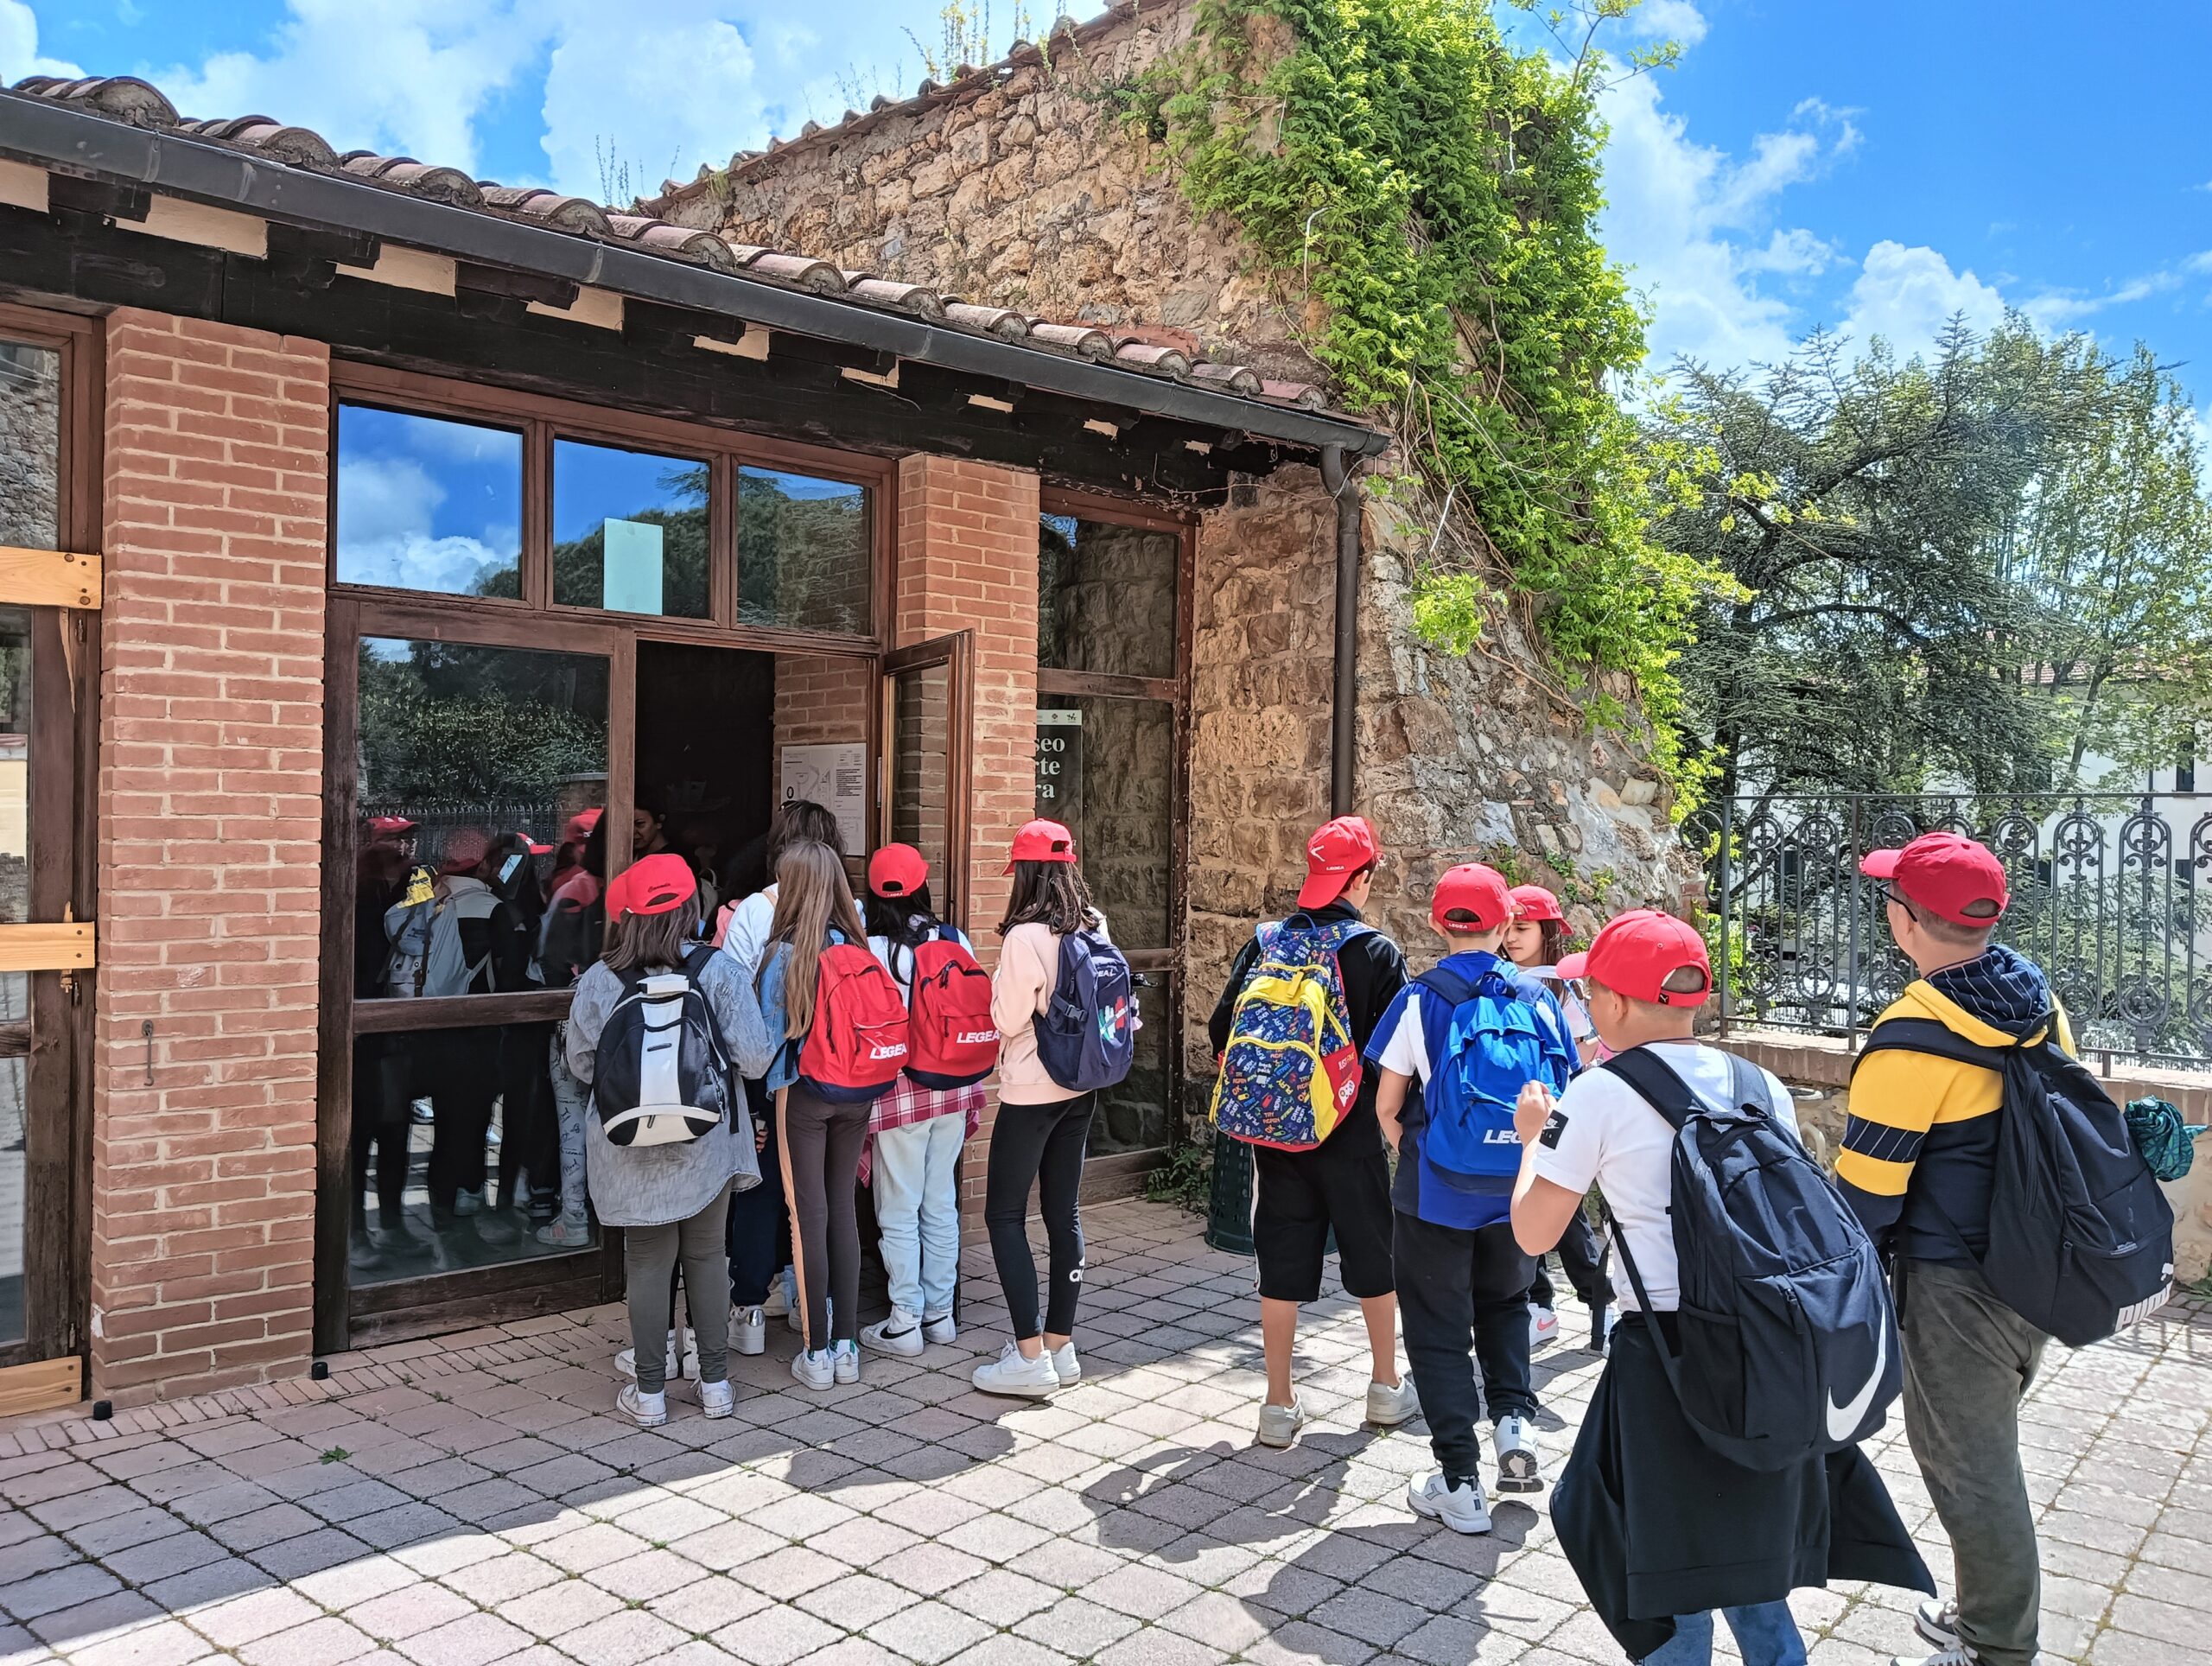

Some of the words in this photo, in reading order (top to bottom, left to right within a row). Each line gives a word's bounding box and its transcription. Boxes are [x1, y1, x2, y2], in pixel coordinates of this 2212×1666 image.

[957, 1029, 1001, 1044] LEGEA
[869, 1043, 907, 1060] LEGEA
[1232, 1084, 1242, 1096] OK
[1276, 1078, 1294, 1095] PLAY
[1243, 1110, 1260, 1126] PLAY
[1291, 1105, 1302, 1121] GAME
[1265, 1124, 1275, 1134] OK
